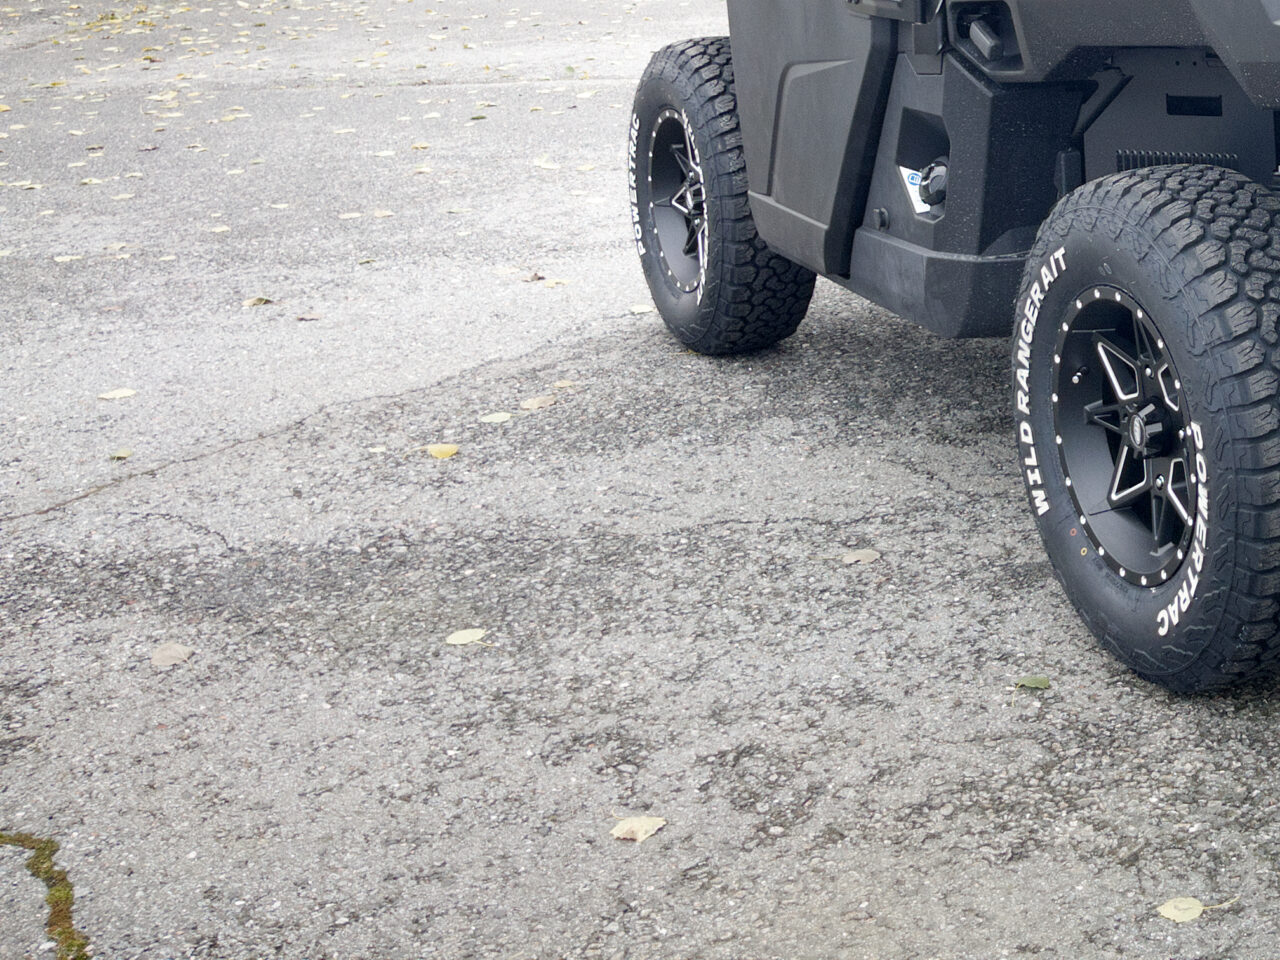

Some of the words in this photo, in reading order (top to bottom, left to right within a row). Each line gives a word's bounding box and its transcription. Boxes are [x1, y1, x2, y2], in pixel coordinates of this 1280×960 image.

[628, 113, 647, 256] POWERTRAC
[1040, 246, 1067, 291] A/T
[1016, 280, 1044, 415] RANGER
[1020, 420, 1050, 516] WILD
[1157, 421, 1209, 636] POWERTRAC
